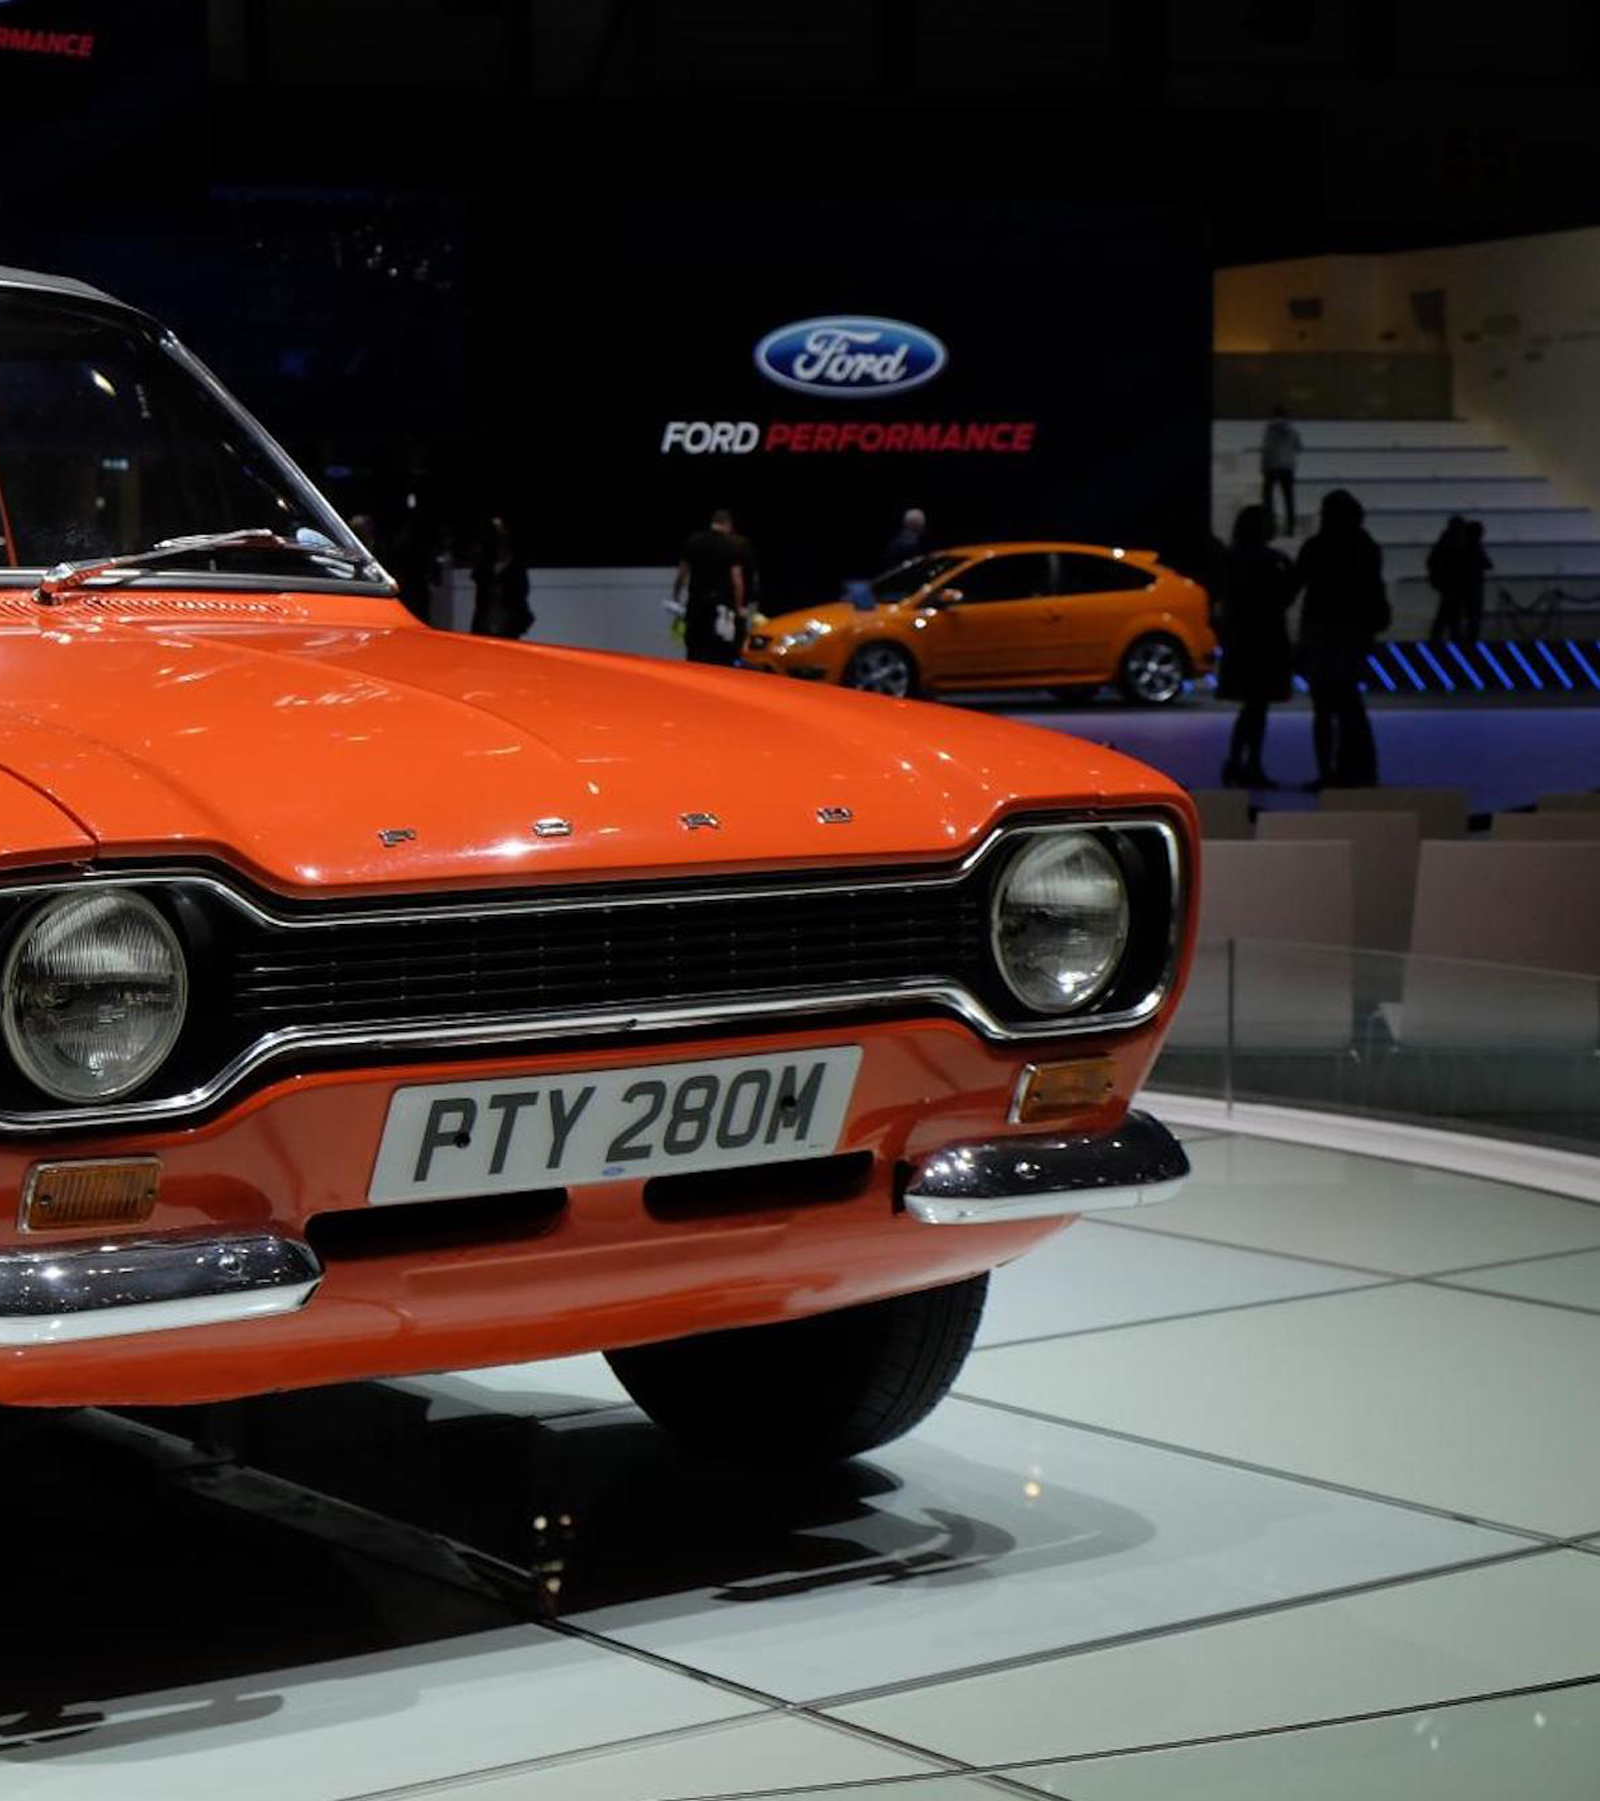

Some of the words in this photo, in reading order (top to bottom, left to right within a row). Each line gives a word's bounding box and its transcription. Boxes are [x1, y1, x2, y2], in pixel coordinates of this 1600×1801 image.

[792, 328, 910, 382] Ford
[661, 421, 760, 454] FORD
[765, 422, 1037, 453] PERFORMANCE
[413, 1085, 597, 1182] PTY
[604, 1061, 827, 1163] 280M
